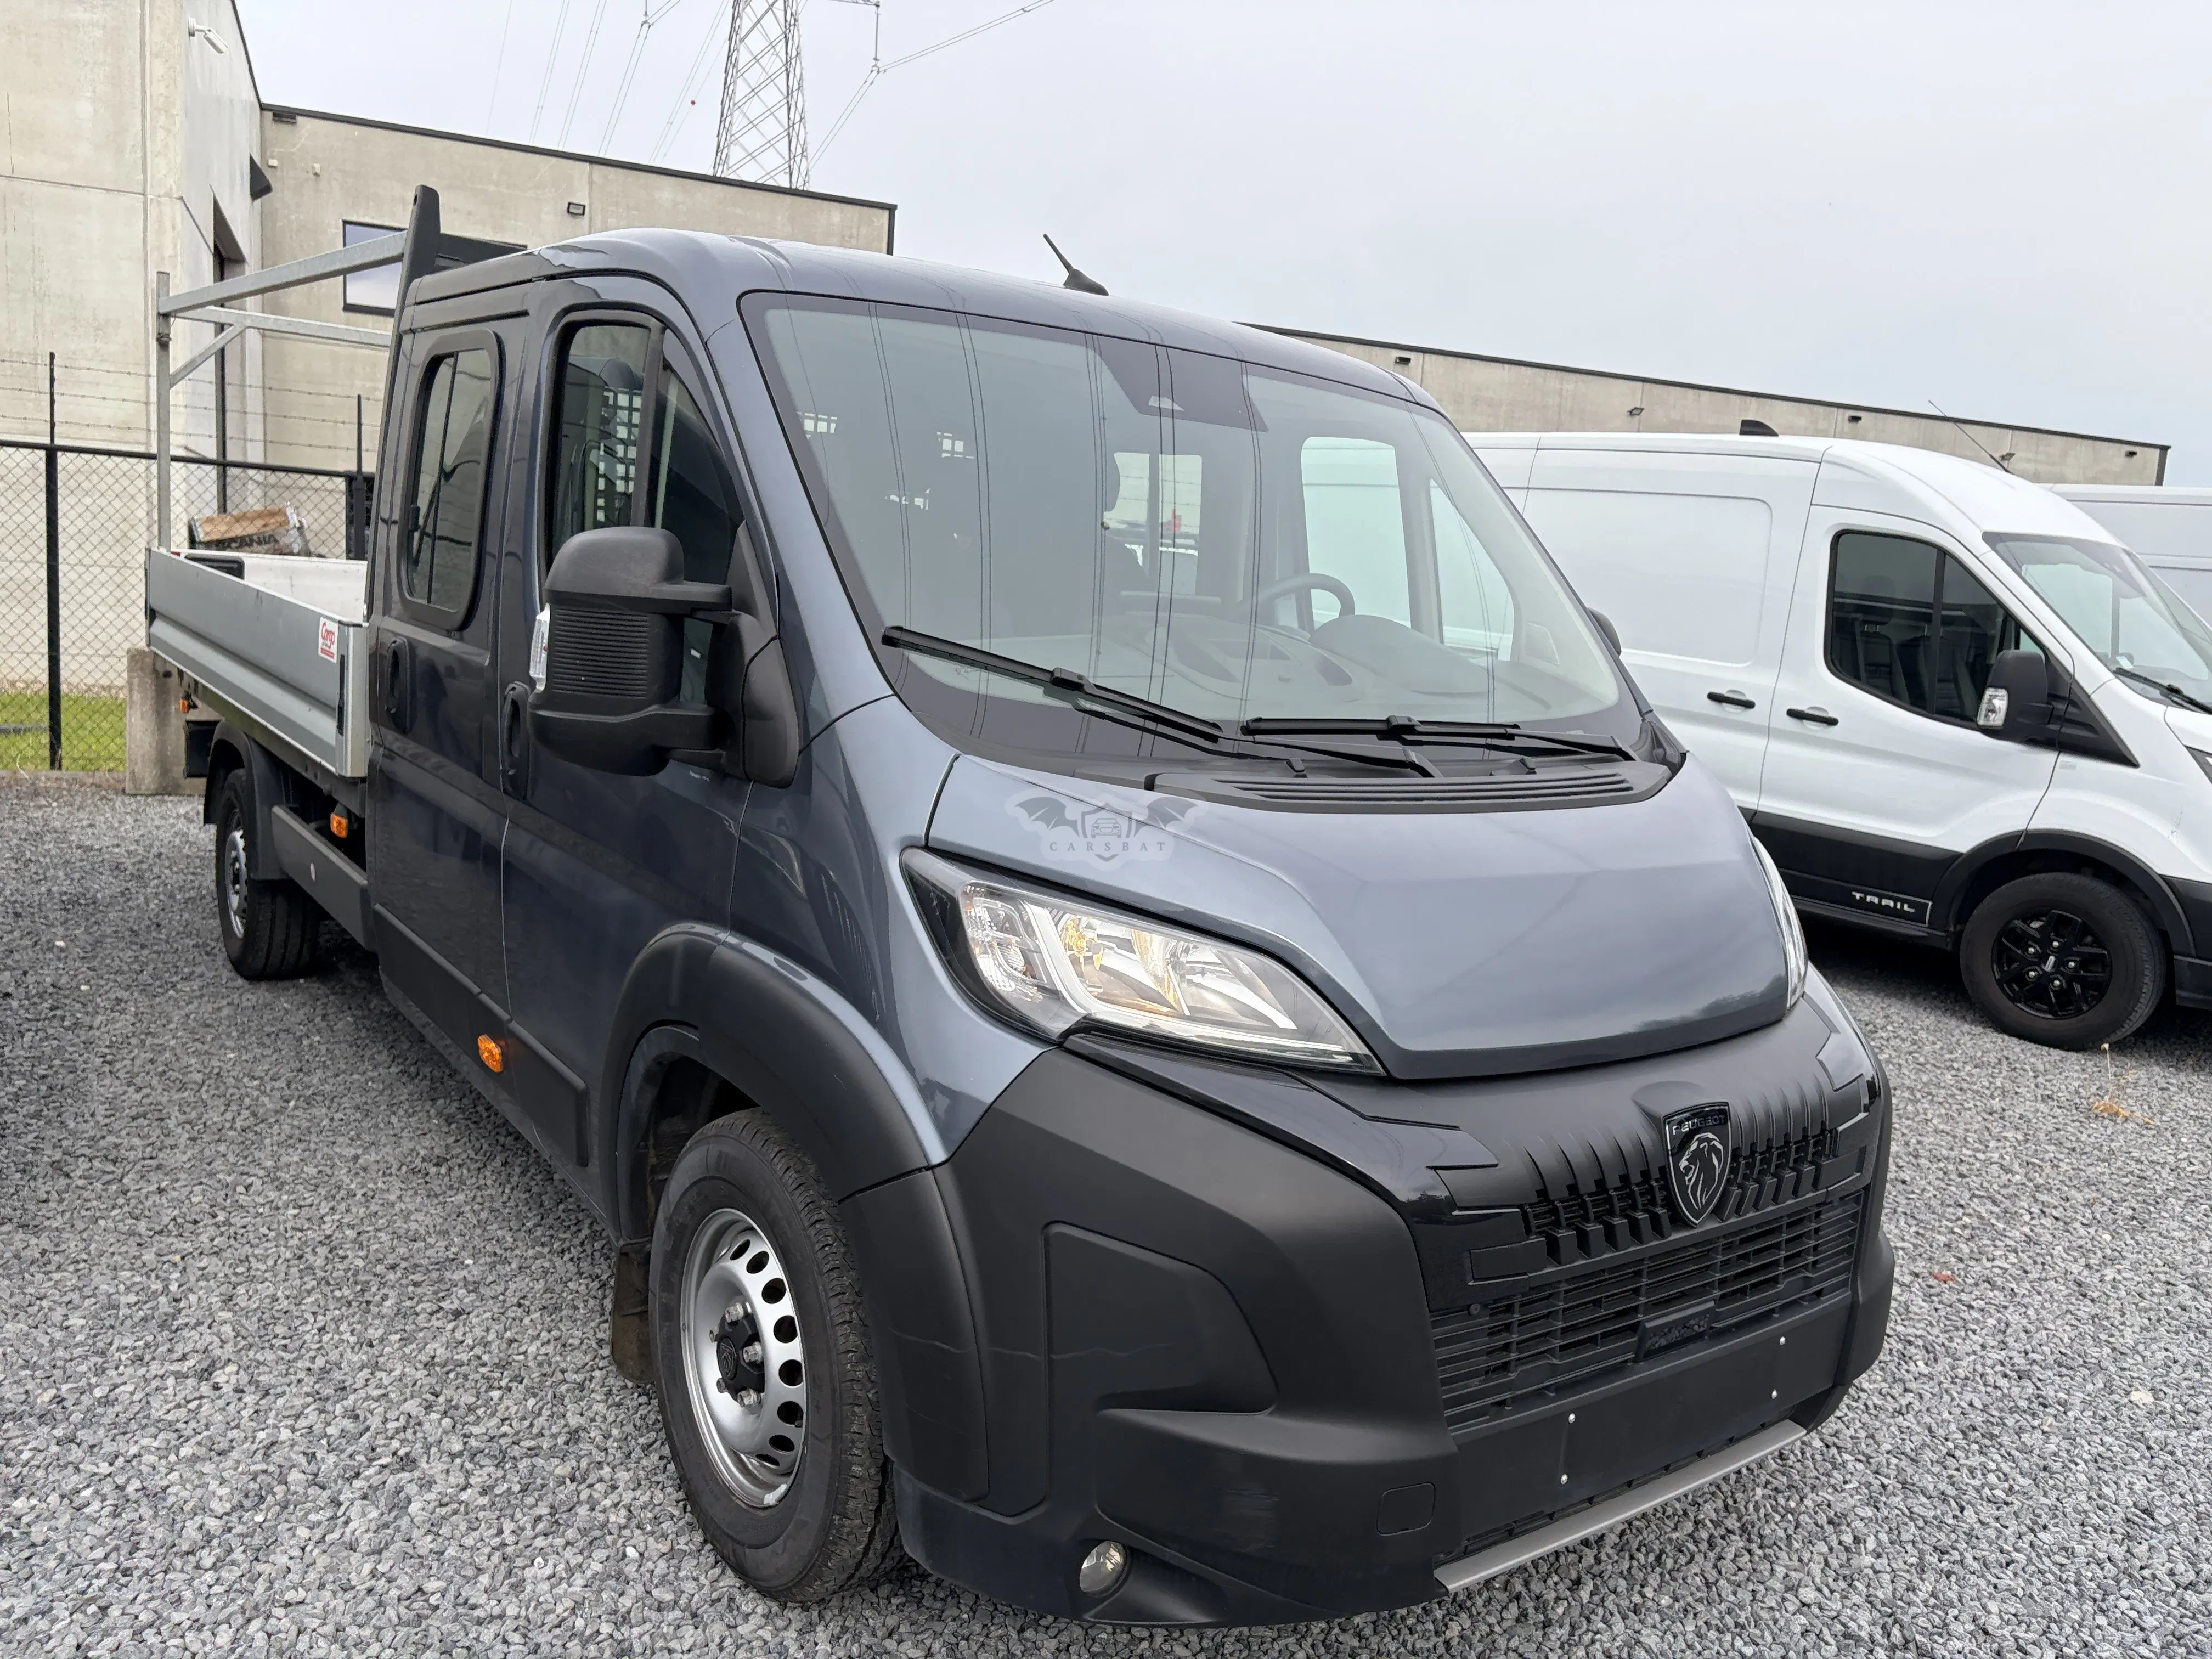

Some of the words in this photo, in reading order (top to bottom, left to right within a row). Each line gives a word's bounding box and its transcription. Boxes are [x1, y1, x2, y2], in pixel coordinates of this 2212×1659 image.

[321, 622, 335, 649] Cargo
[1852, 891, 1916, 913] TRAIL
[1672, 1115, 1725, 1136] PEUGEOT
